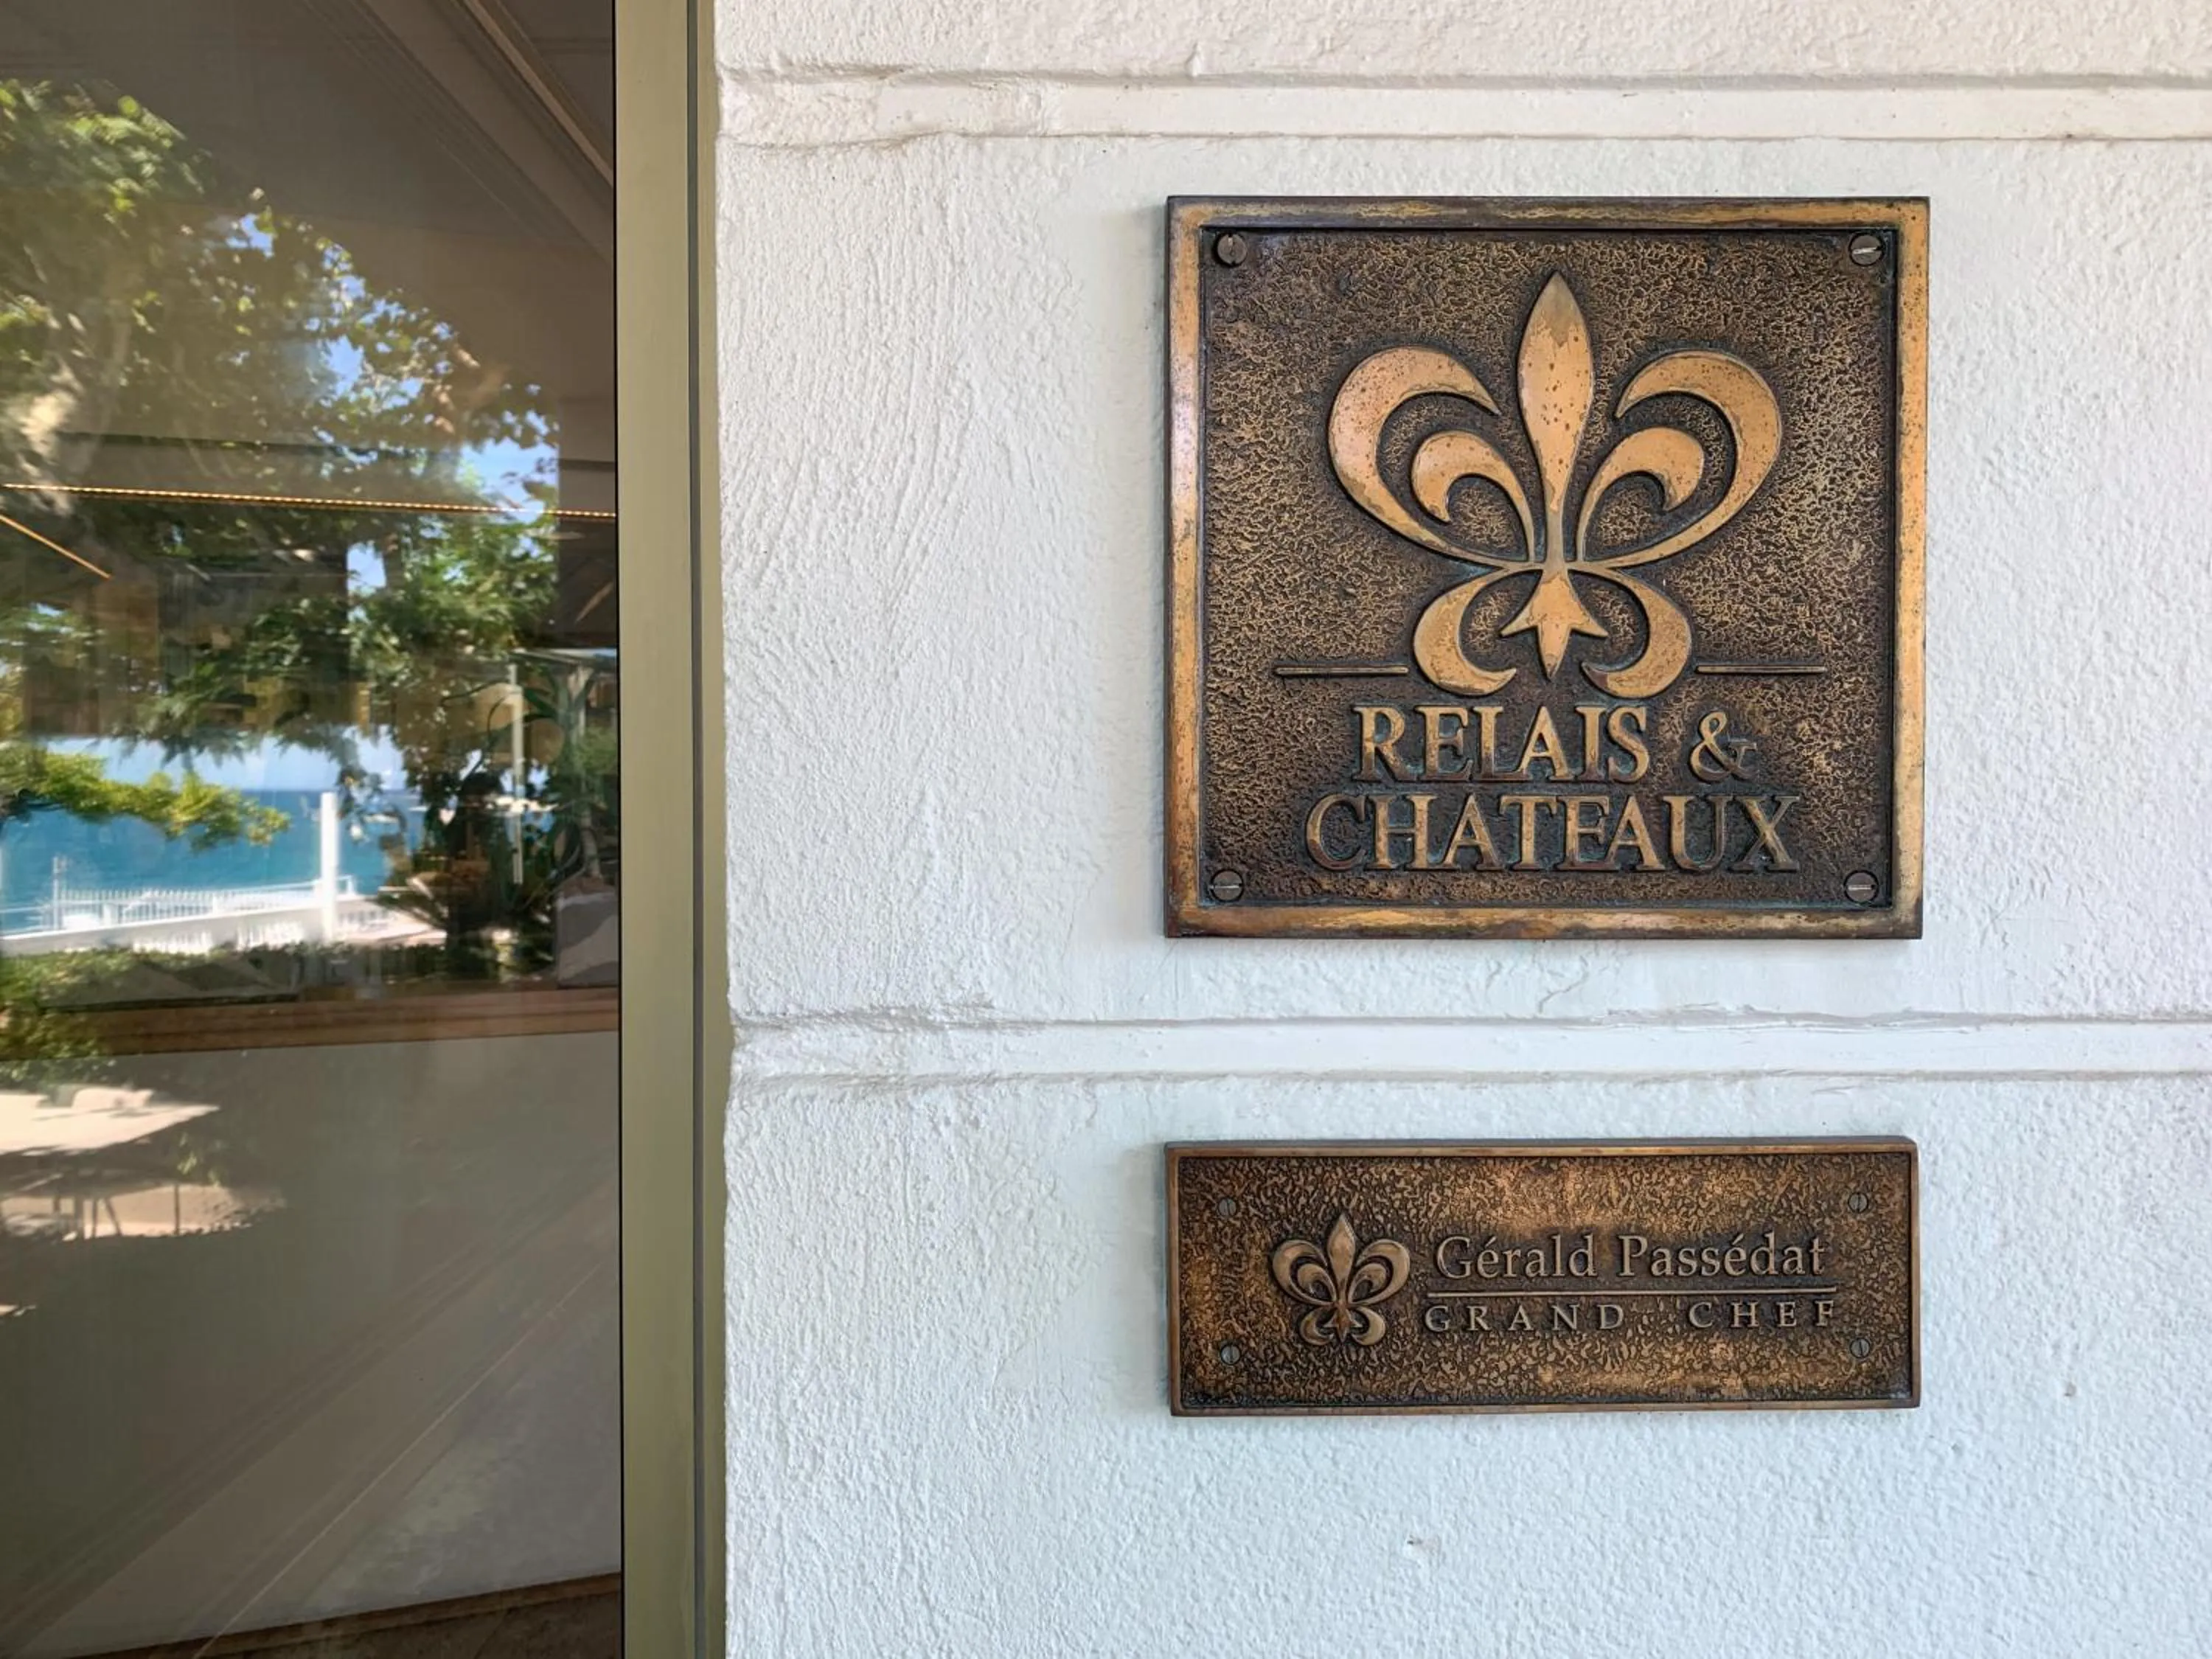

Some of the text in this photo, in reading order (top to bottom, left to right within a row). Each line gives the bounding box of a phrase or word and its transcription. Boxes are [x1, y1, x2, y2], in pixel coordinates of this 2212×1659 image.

[1354, 705, 1757, 782] RELAIS &
[1305, 793, 1801, 872] CHATEAUX
[1436, 1232, 1826, 1279] Gérald Passédat
[1424, 1299, 1834, 1332] GRAND CHEF
